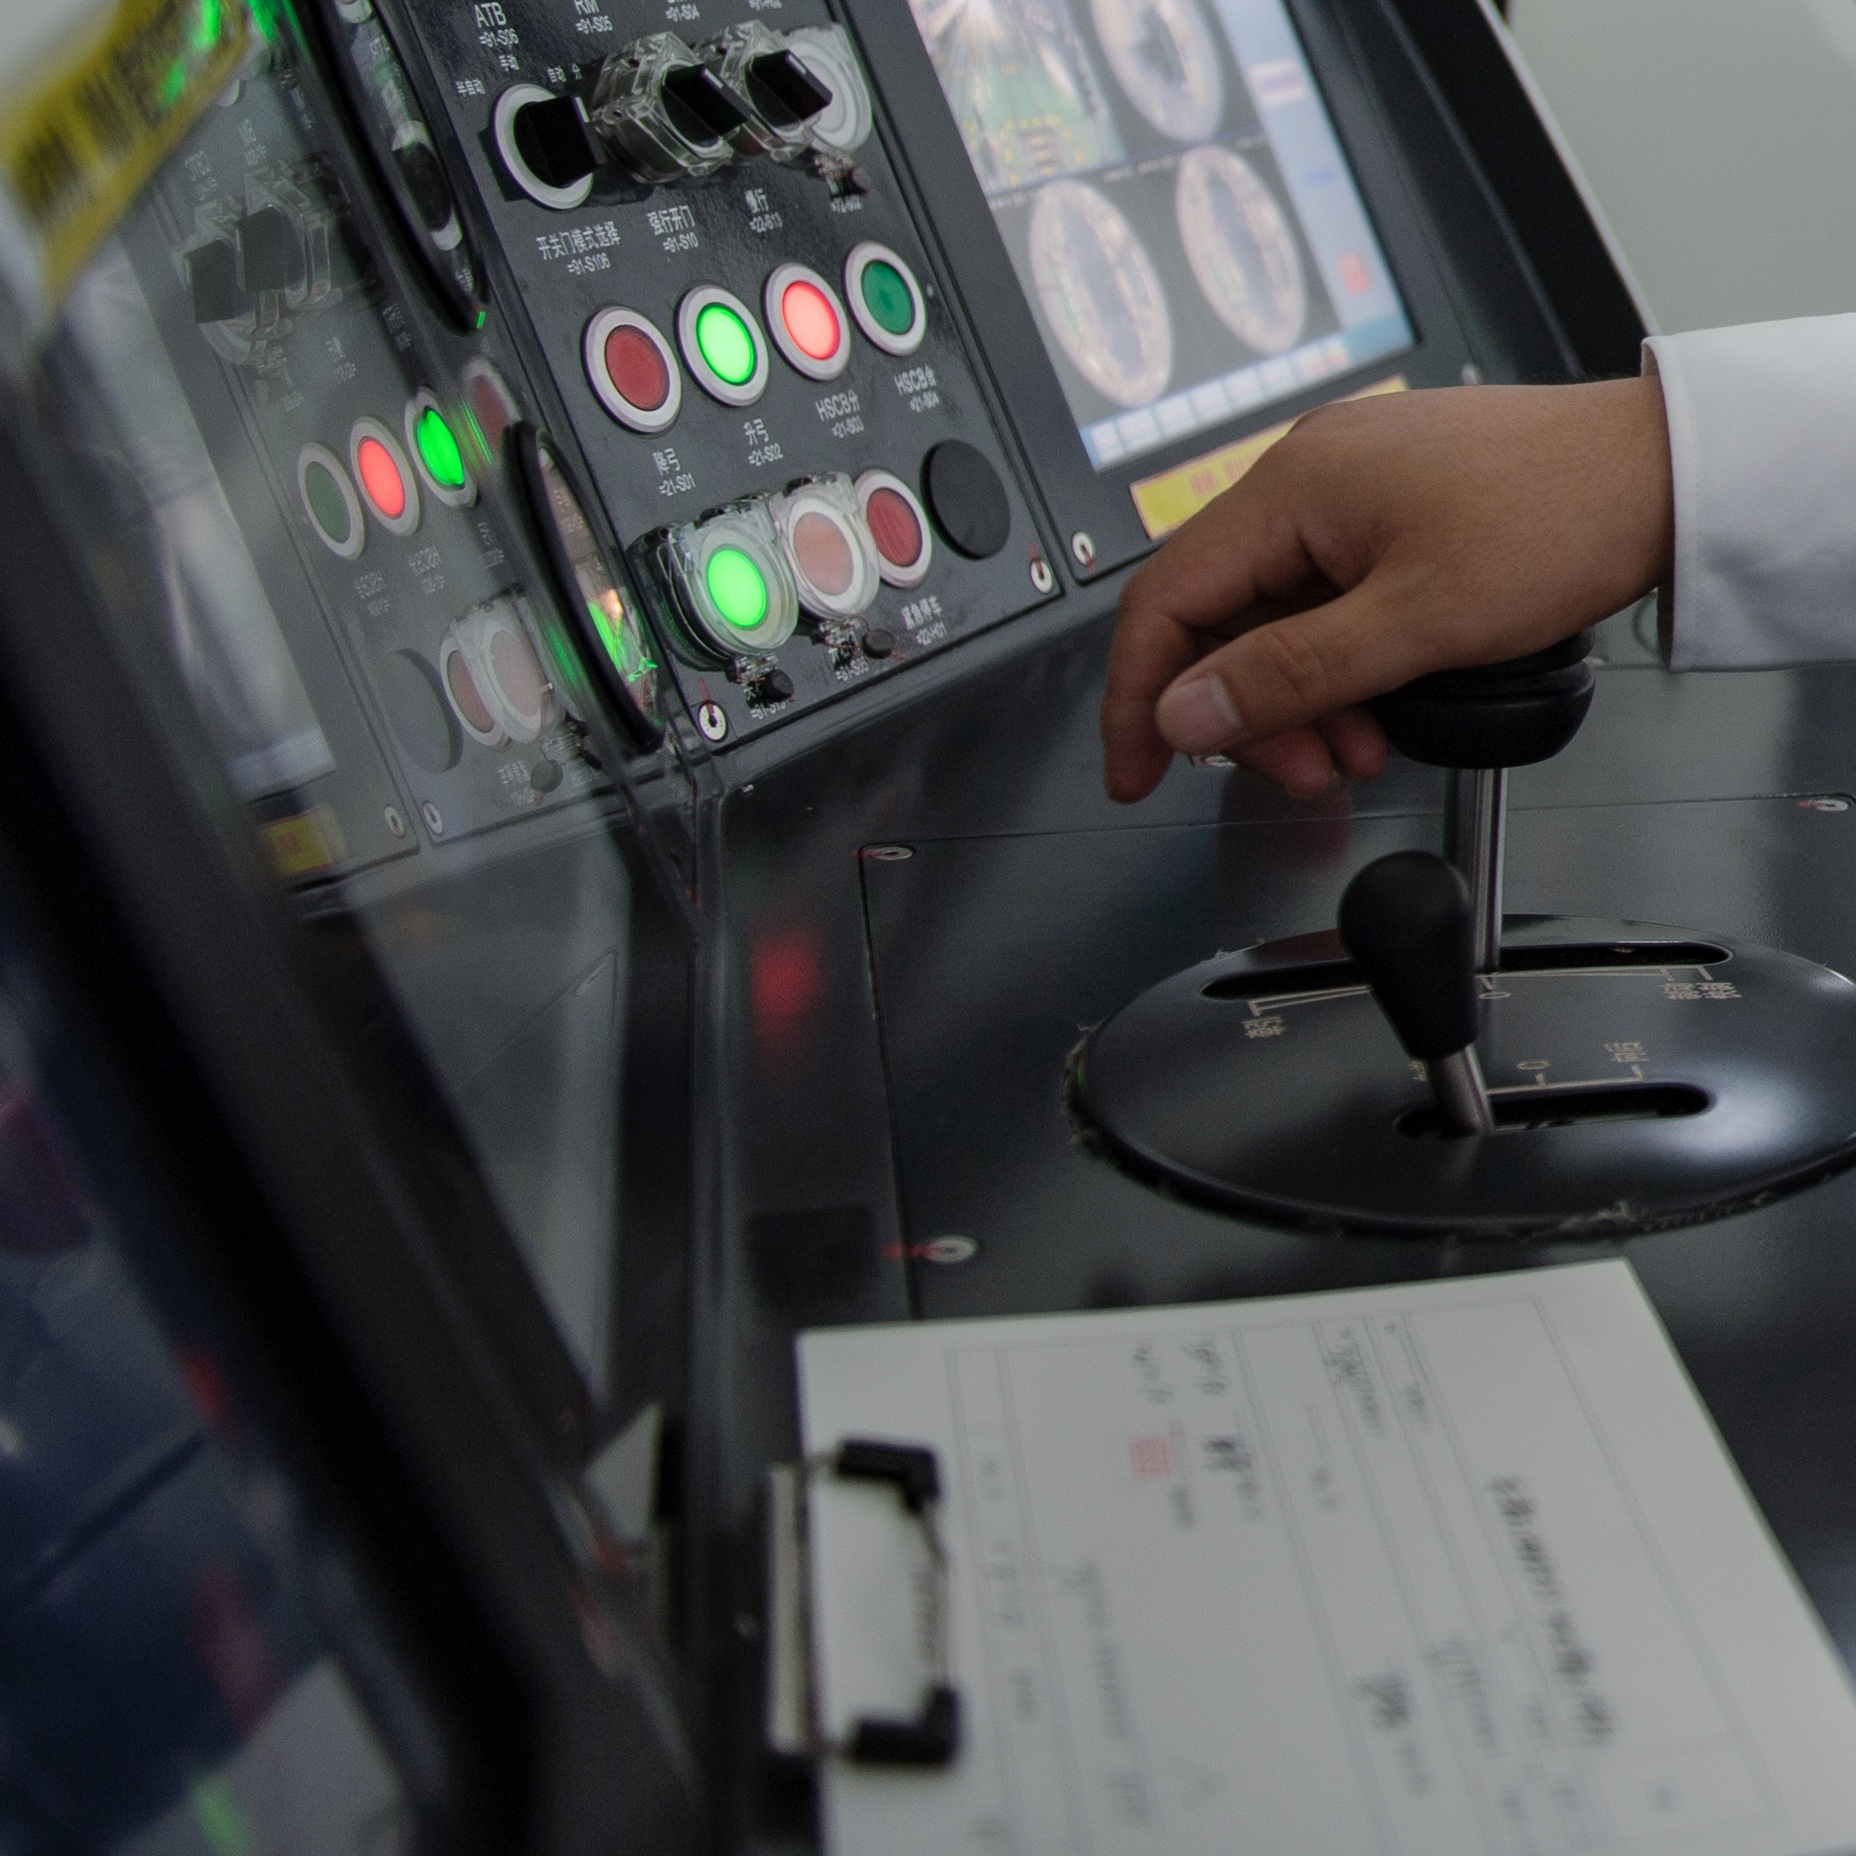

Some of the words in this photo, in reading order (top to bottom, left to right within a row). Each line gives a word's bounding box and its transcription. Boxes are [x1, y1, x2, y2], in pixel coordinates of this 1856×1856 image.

[474, 1, 507, 28] ATB
[575, 15, 613, 34] =91-S05
[478, 28, 519, 48] =91-S06
[646, 205, 696, 236] 强行开门
[535, 221, 621, 261] 开关门模式选择
[662, 232, 699, 253] =91-S10
[567, 252, 611, 276] =91-S106
[815, 388, 861, 422] HSCB分
[743, 418, 769, 446] 升弓
[652, 447, 681, 476] 降弓
[748, 442, 784, 467] =21-S02
[658, 472, 696, 497] =21-S01
